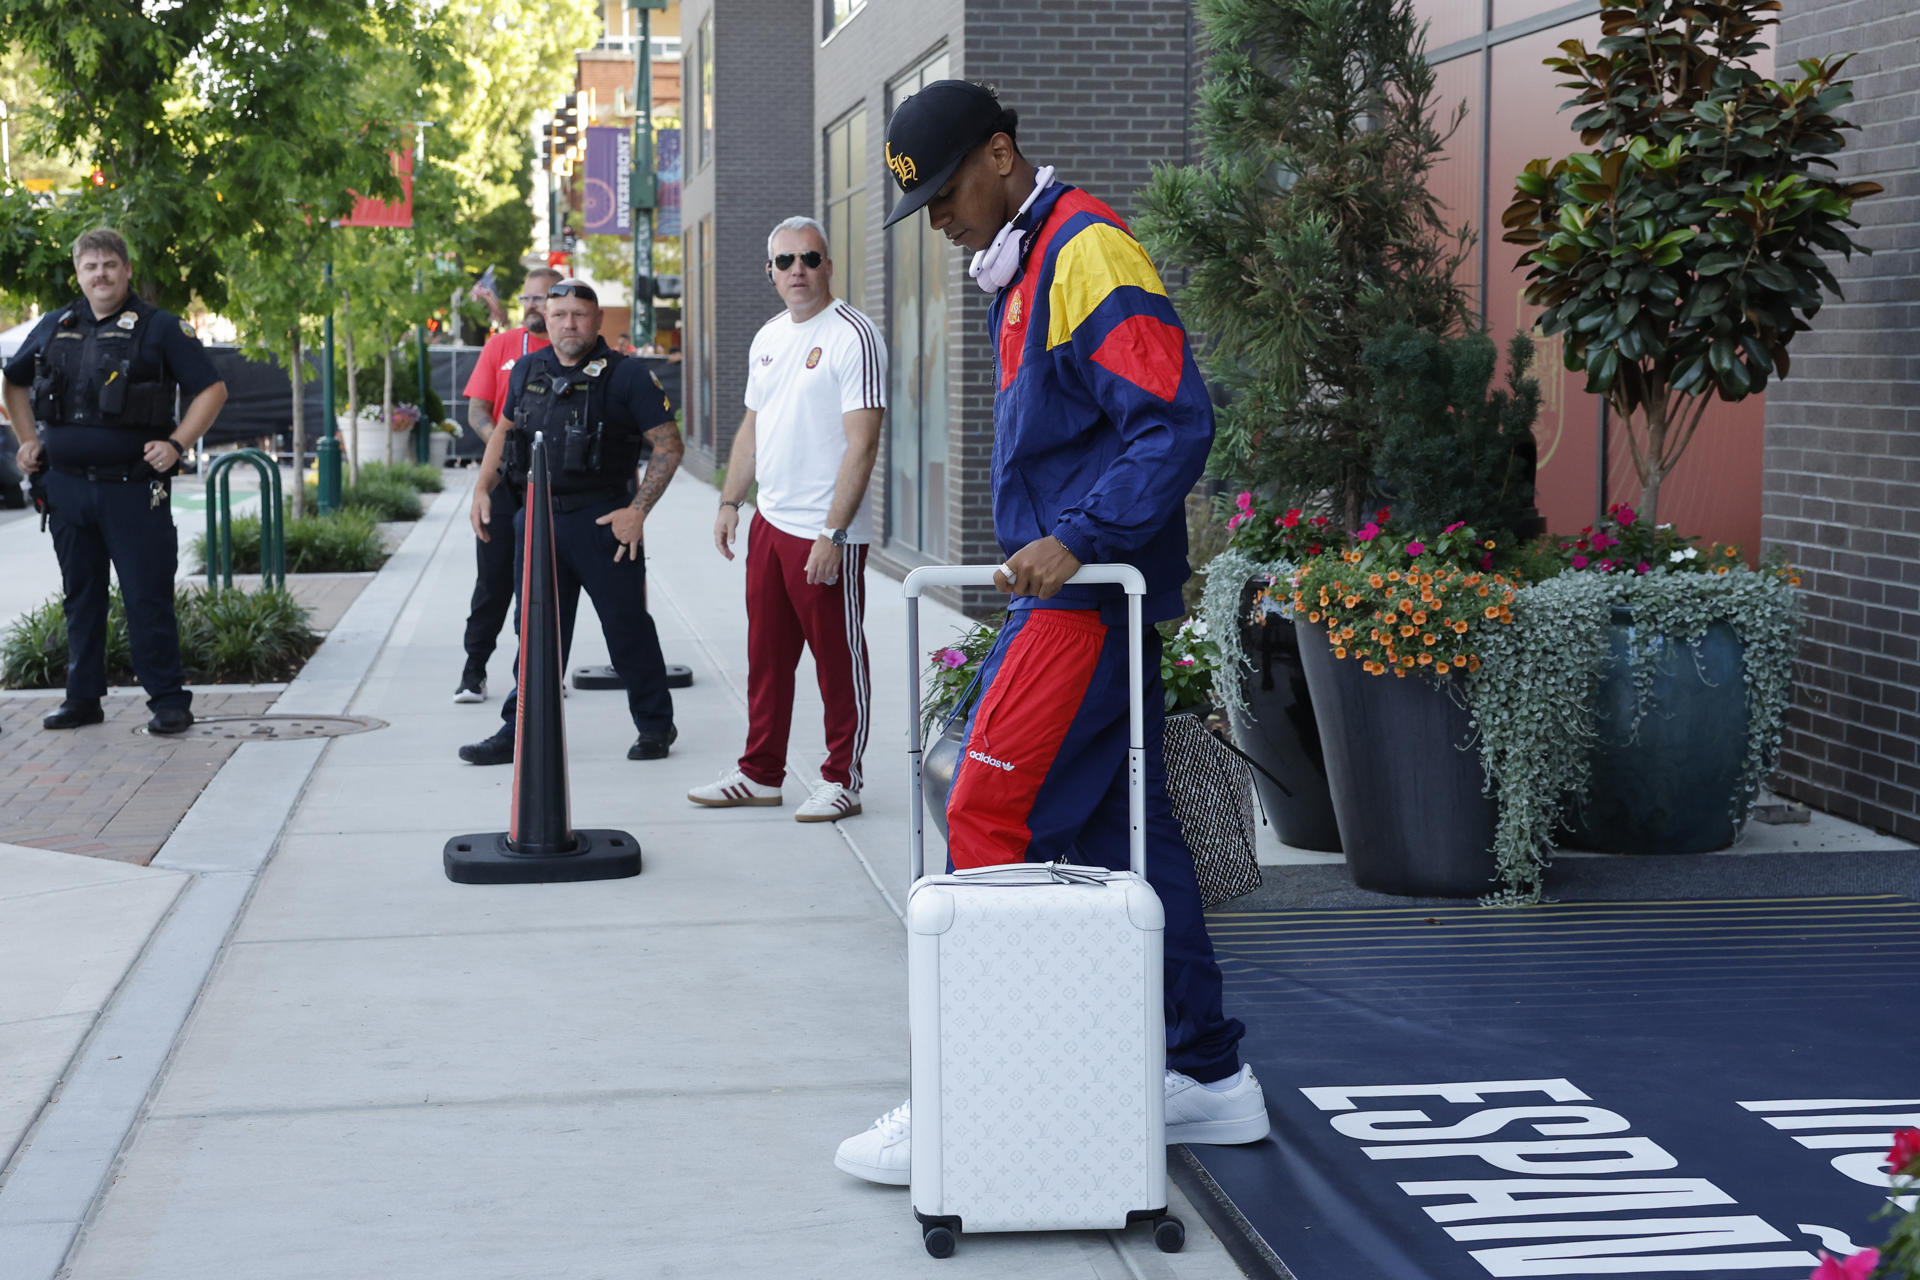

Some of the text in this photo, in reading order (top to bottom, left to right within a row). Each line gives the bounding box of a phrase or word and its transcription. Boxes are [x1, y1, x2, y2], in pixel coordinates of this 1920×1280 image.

[616, 133, 630, 228] RIVERFRONT
[969, 750, 1001, 768] adidas
[1298, 1078, 1872, 1279] ESPAÑ
